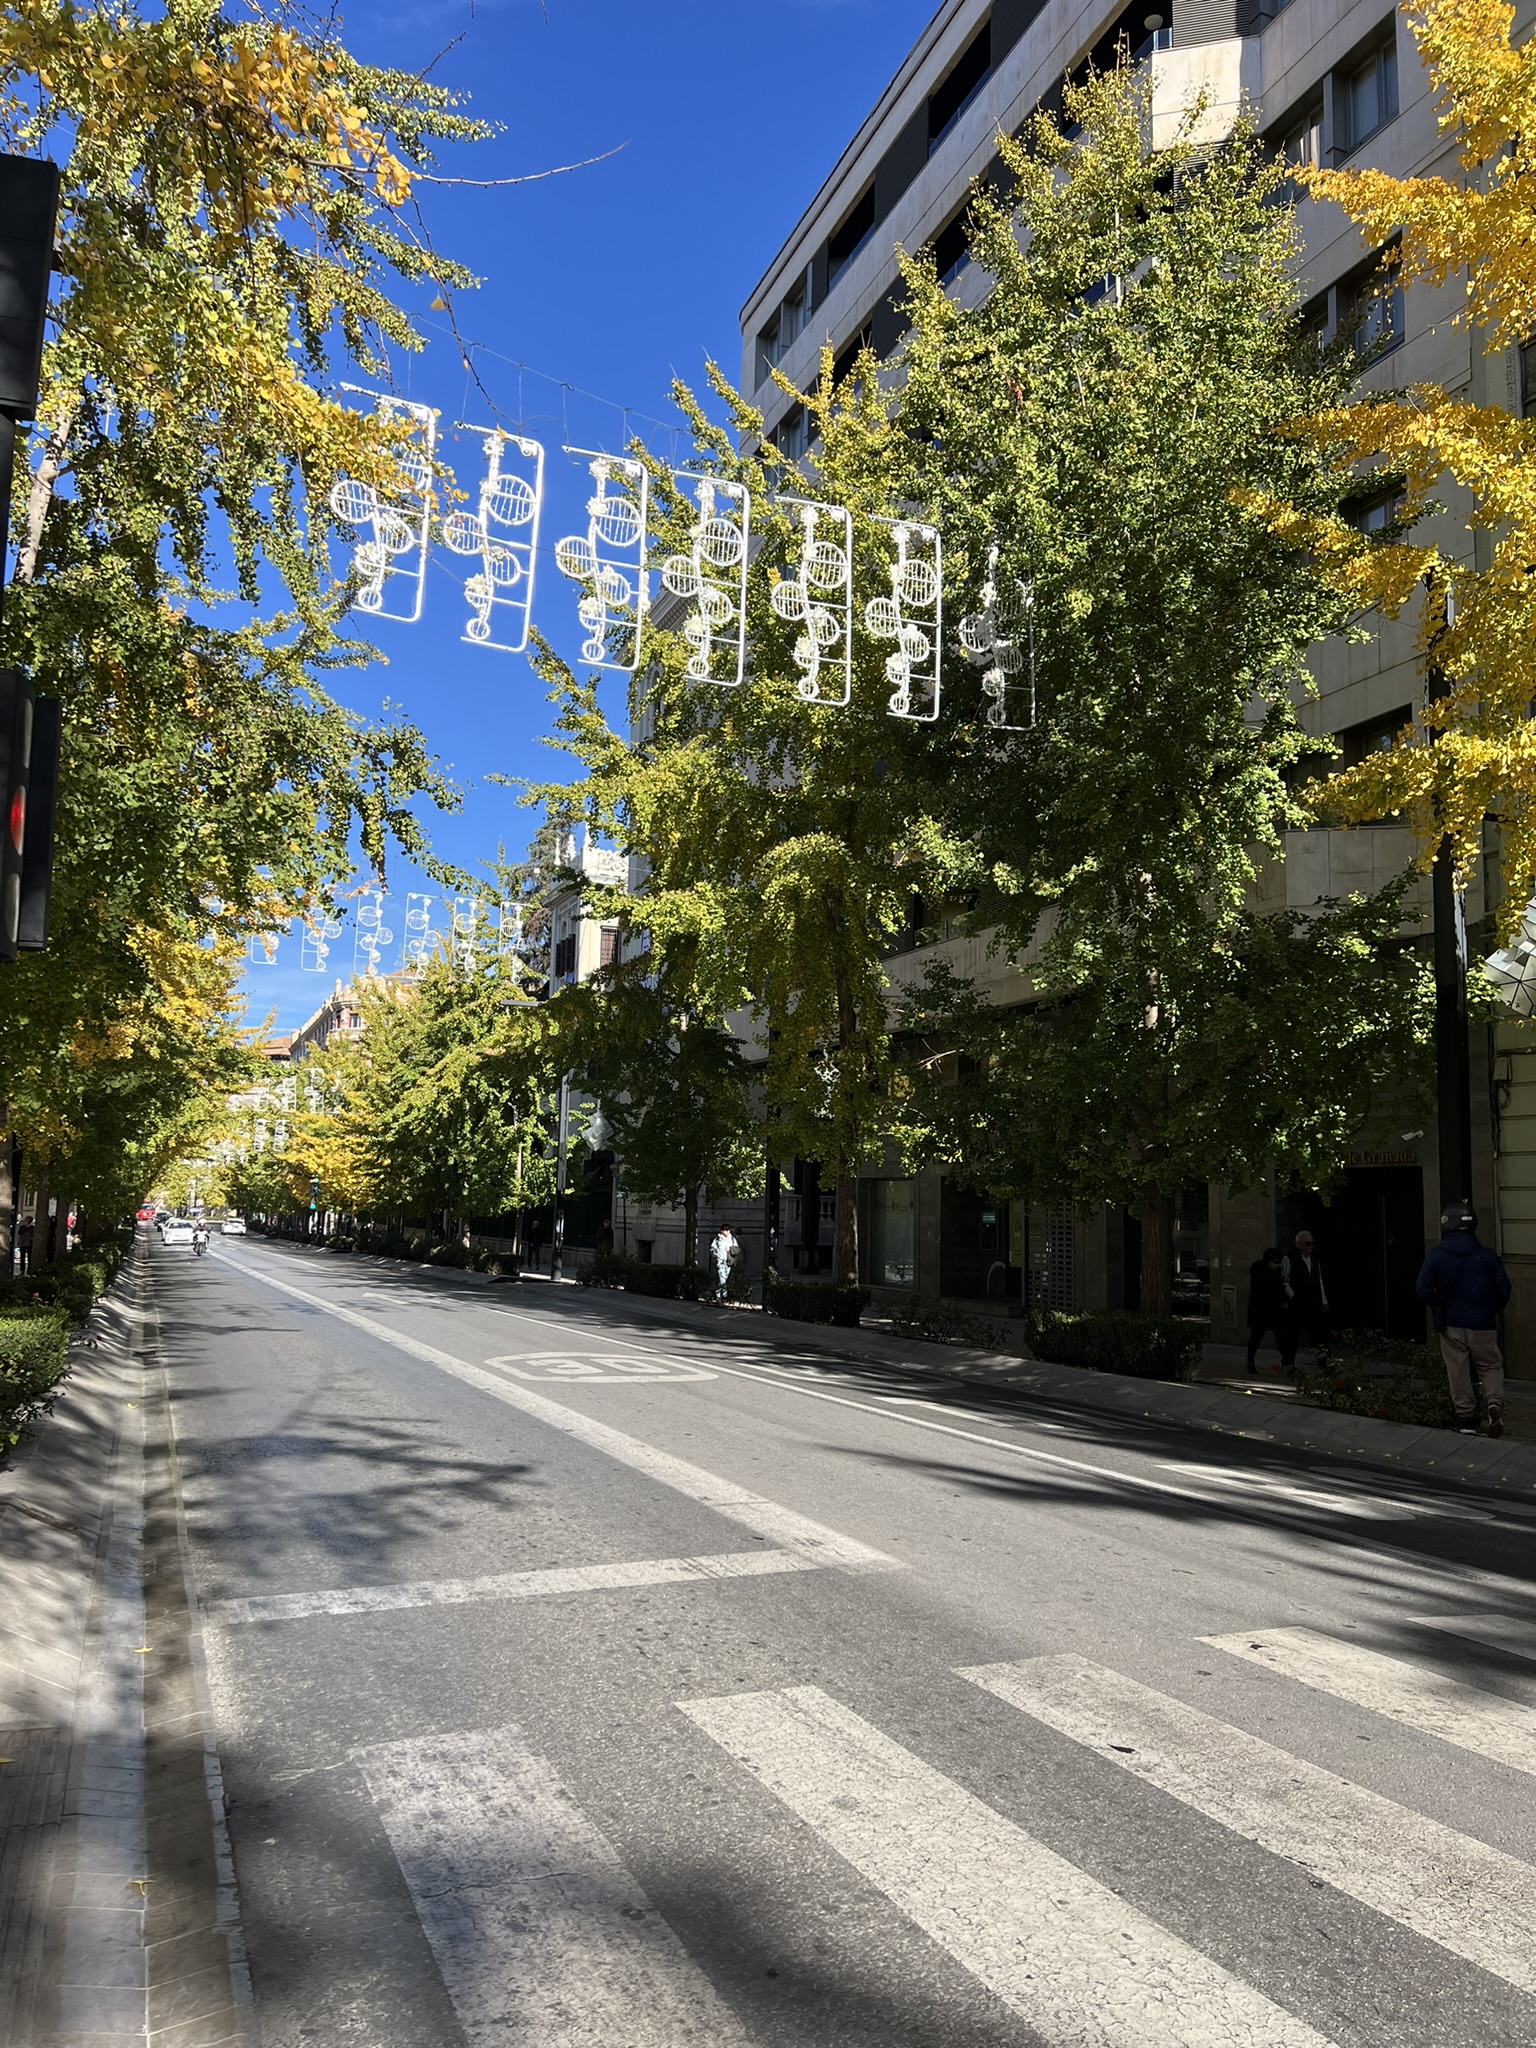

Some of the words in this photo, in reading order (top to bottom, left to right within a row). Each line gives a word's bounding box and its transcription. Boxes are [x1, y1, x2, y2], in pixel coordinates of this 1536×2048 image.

[1362, 1150, 1416, 1164] Granada
[525, 1358, 670, 1374] 30
[872, 1396, 1190, 1431] TAXI
[1155, 1464, 1536, 1521] BUS
